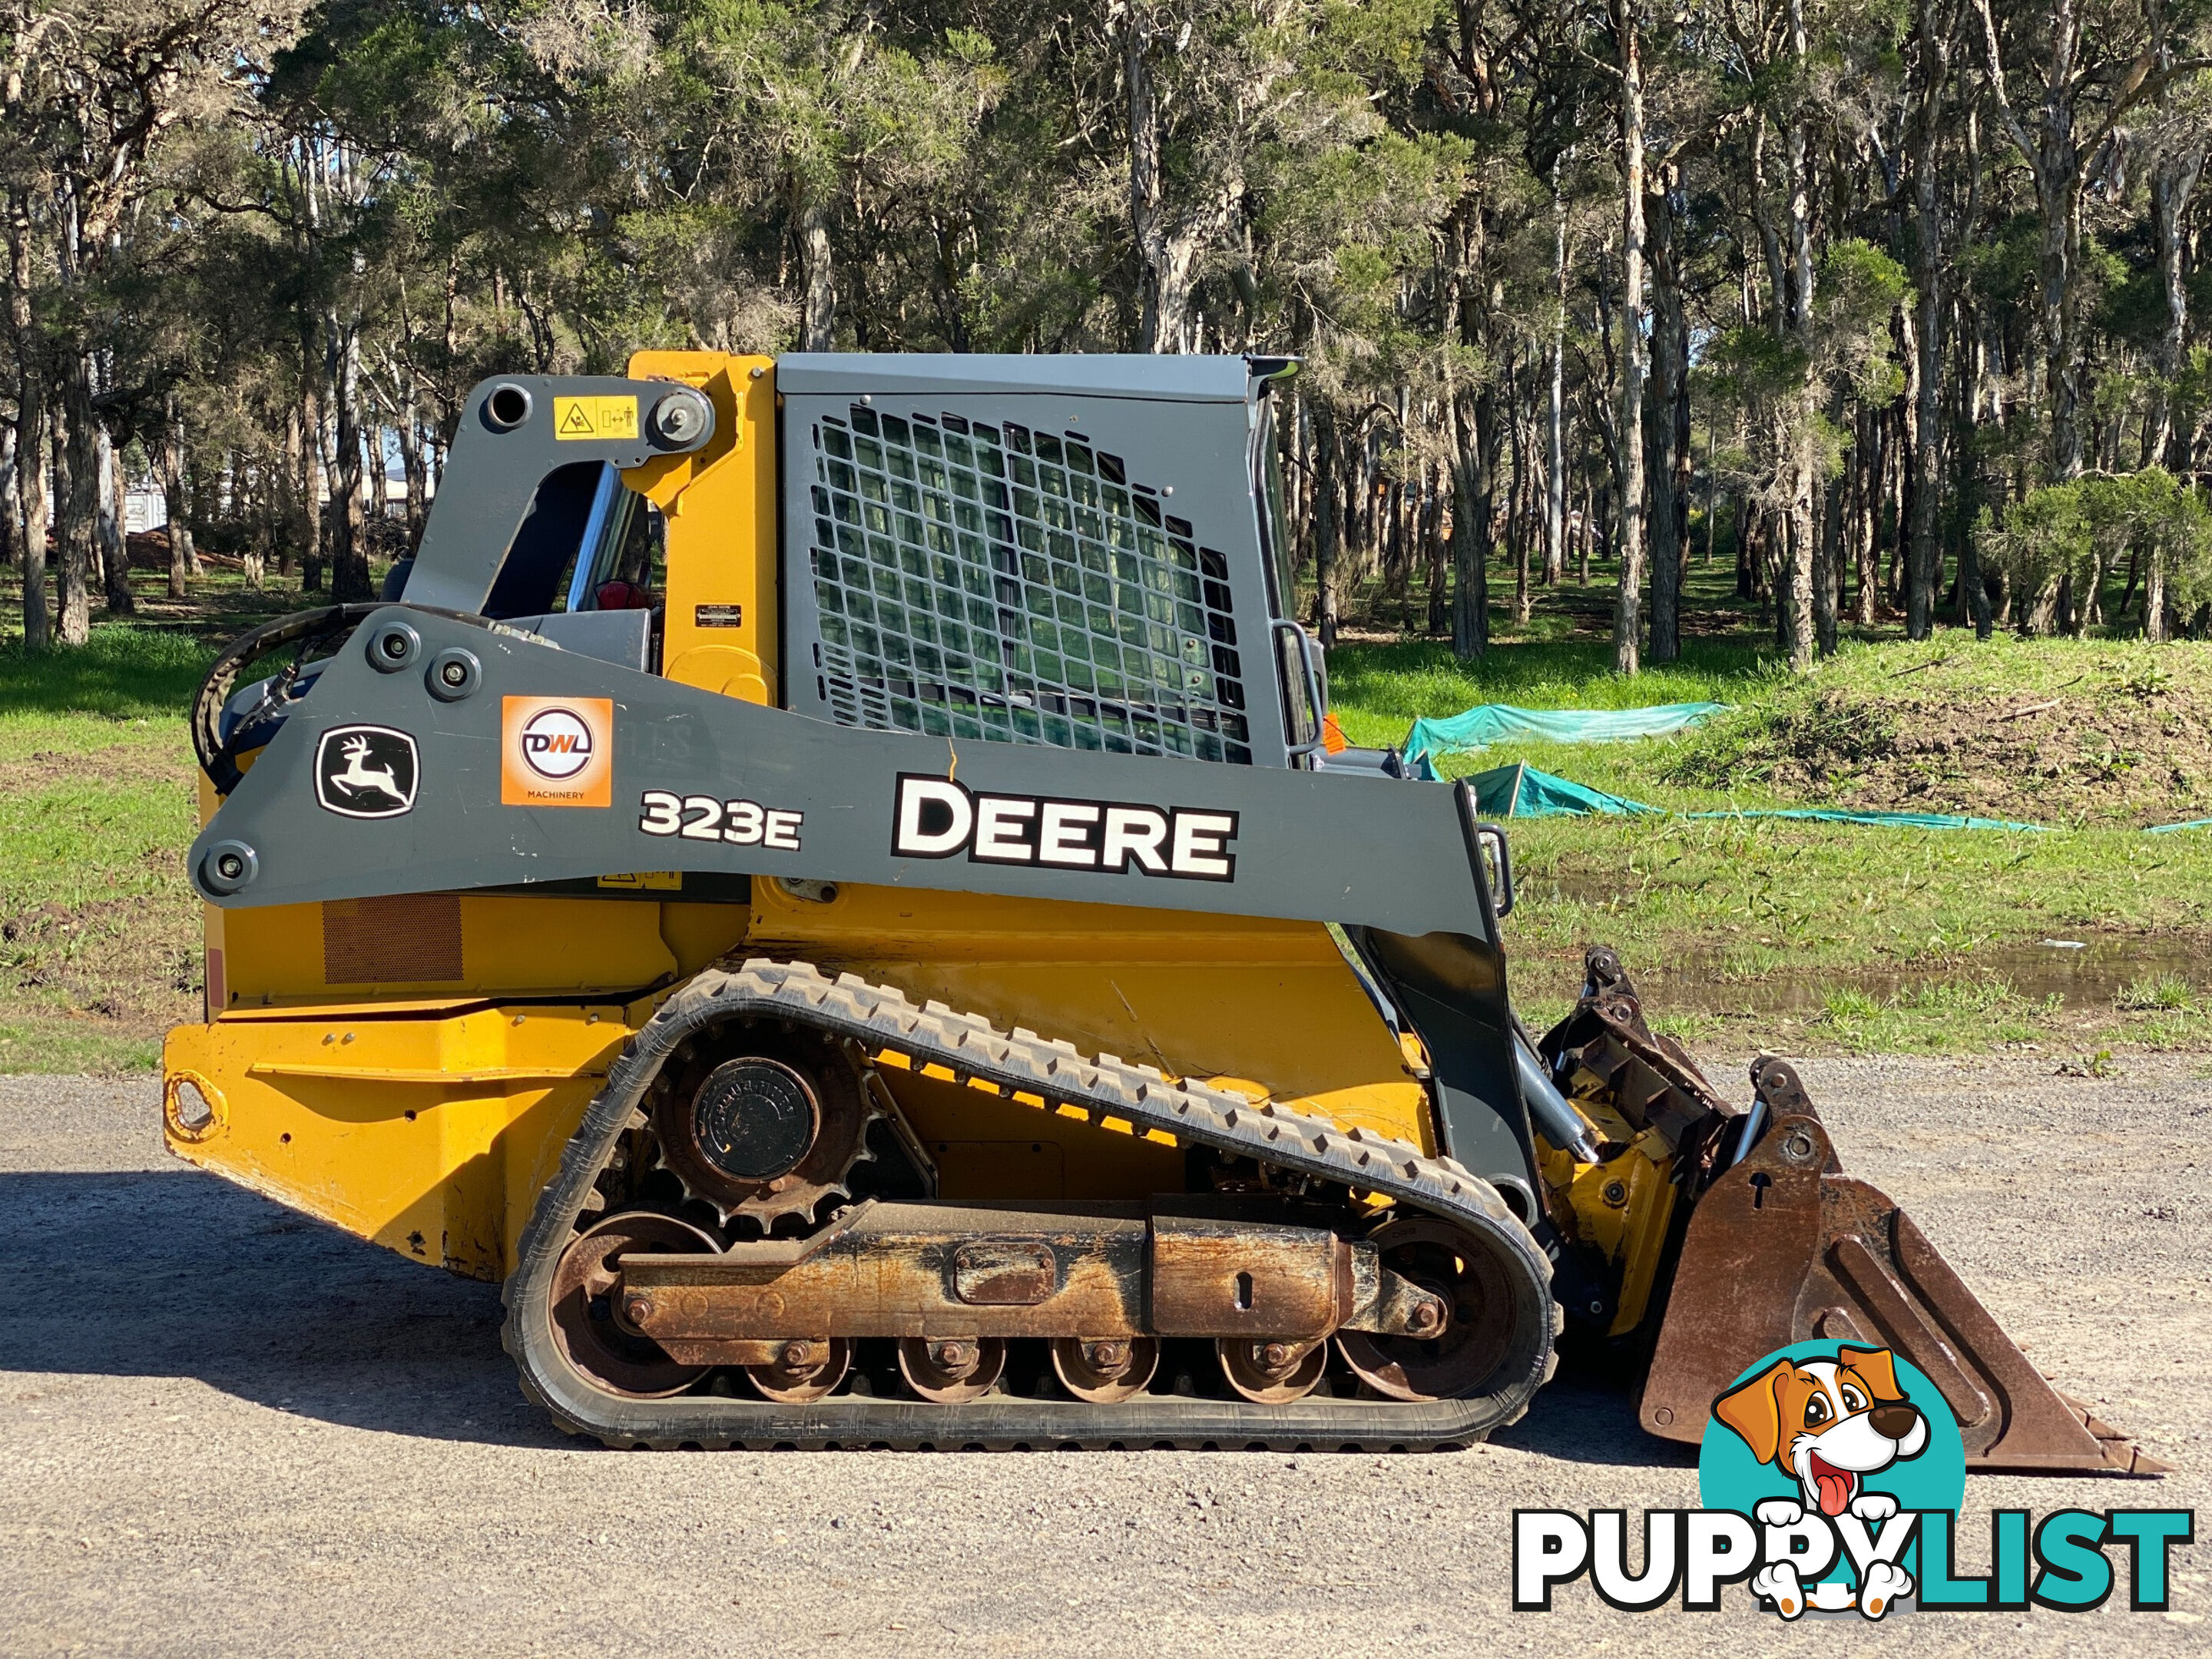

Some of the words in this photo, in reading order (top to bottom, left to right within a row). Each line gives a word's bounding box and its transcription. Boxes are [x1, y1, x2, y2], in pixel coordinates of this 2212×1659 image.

[522, 733, 592, 753] DWL
[528, 790, 585, 800] MACHINERY
[639, 791, 803, 851] 323E
[893, 773, 1237, 880] DEERE
